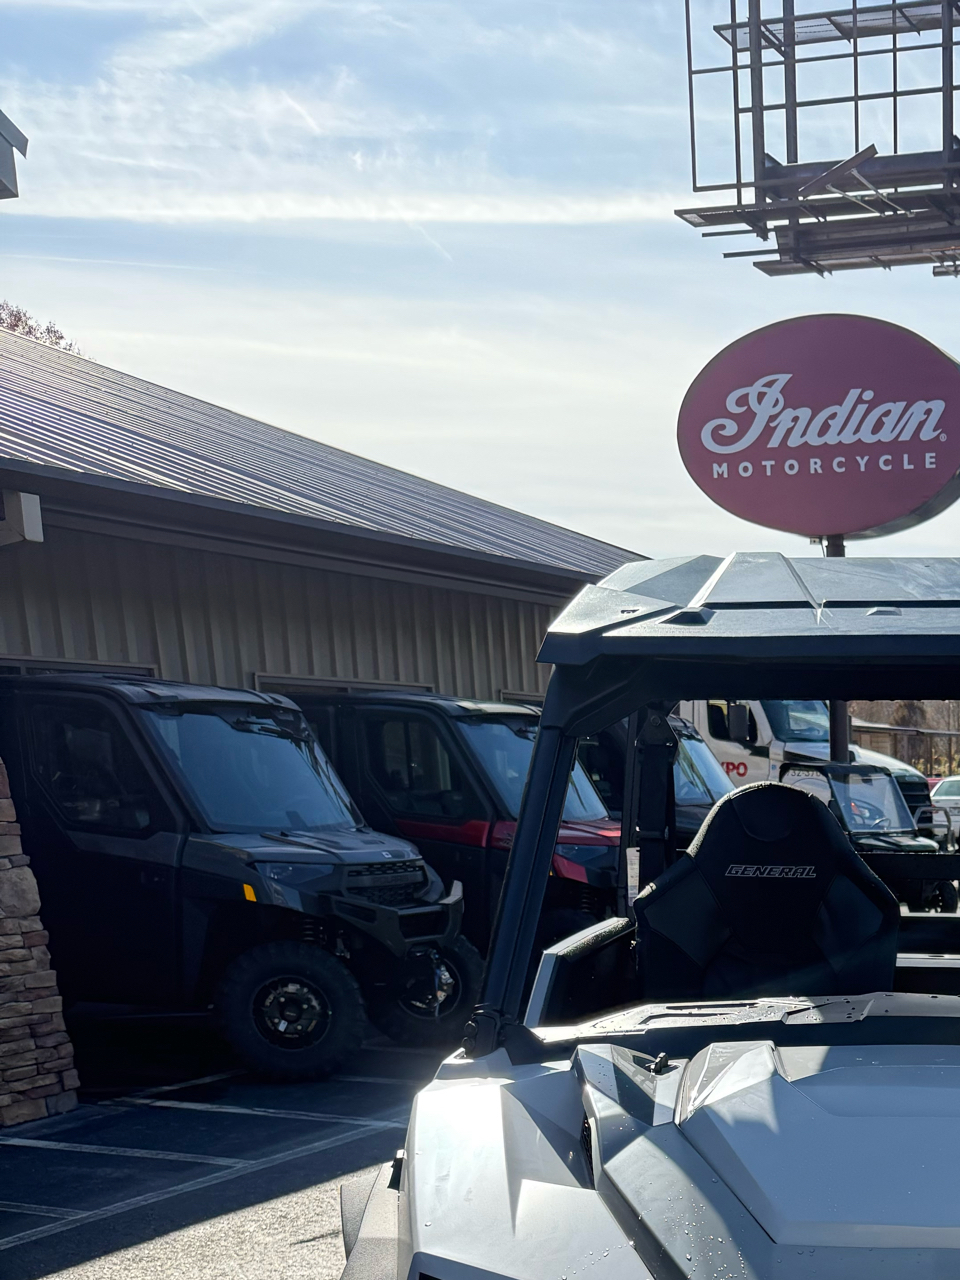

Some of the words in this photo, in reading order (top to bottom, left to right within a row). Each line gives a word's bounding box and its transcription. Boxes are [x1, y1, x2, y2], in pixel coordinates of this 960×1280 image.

[701, 373, 946, 454] Indian
[713, 453, 937, 478] MOTORCYCLE
[721, 762, 748, 777] PO
[725, 864, 816, 878] GENERAL
